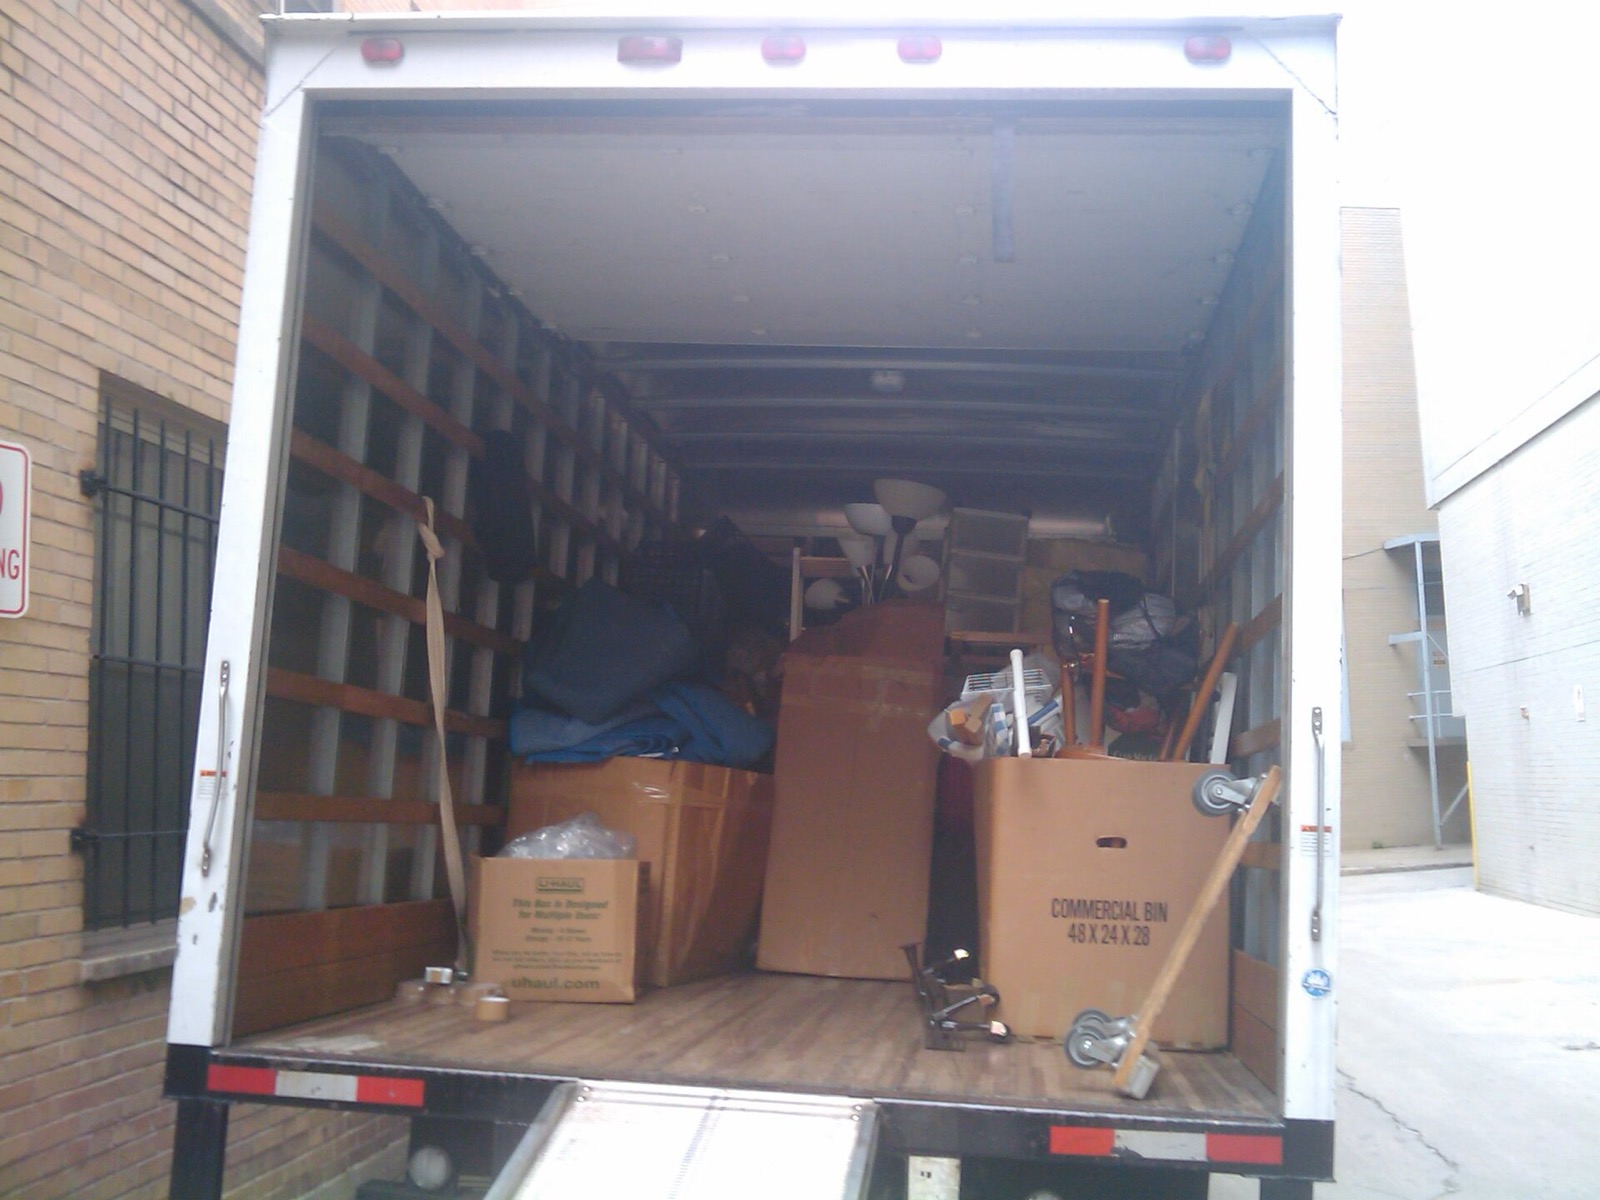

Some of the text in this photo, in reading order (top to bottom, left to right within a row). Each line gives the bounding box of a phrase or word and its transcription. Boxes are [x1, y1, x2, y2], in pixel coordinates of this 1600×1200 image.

[534, 911, 573, 921] Multiple
[1051, 898, 1168, 923] COMMERCIAL BIN
[510, 977, 600, 989] uhaul.com
